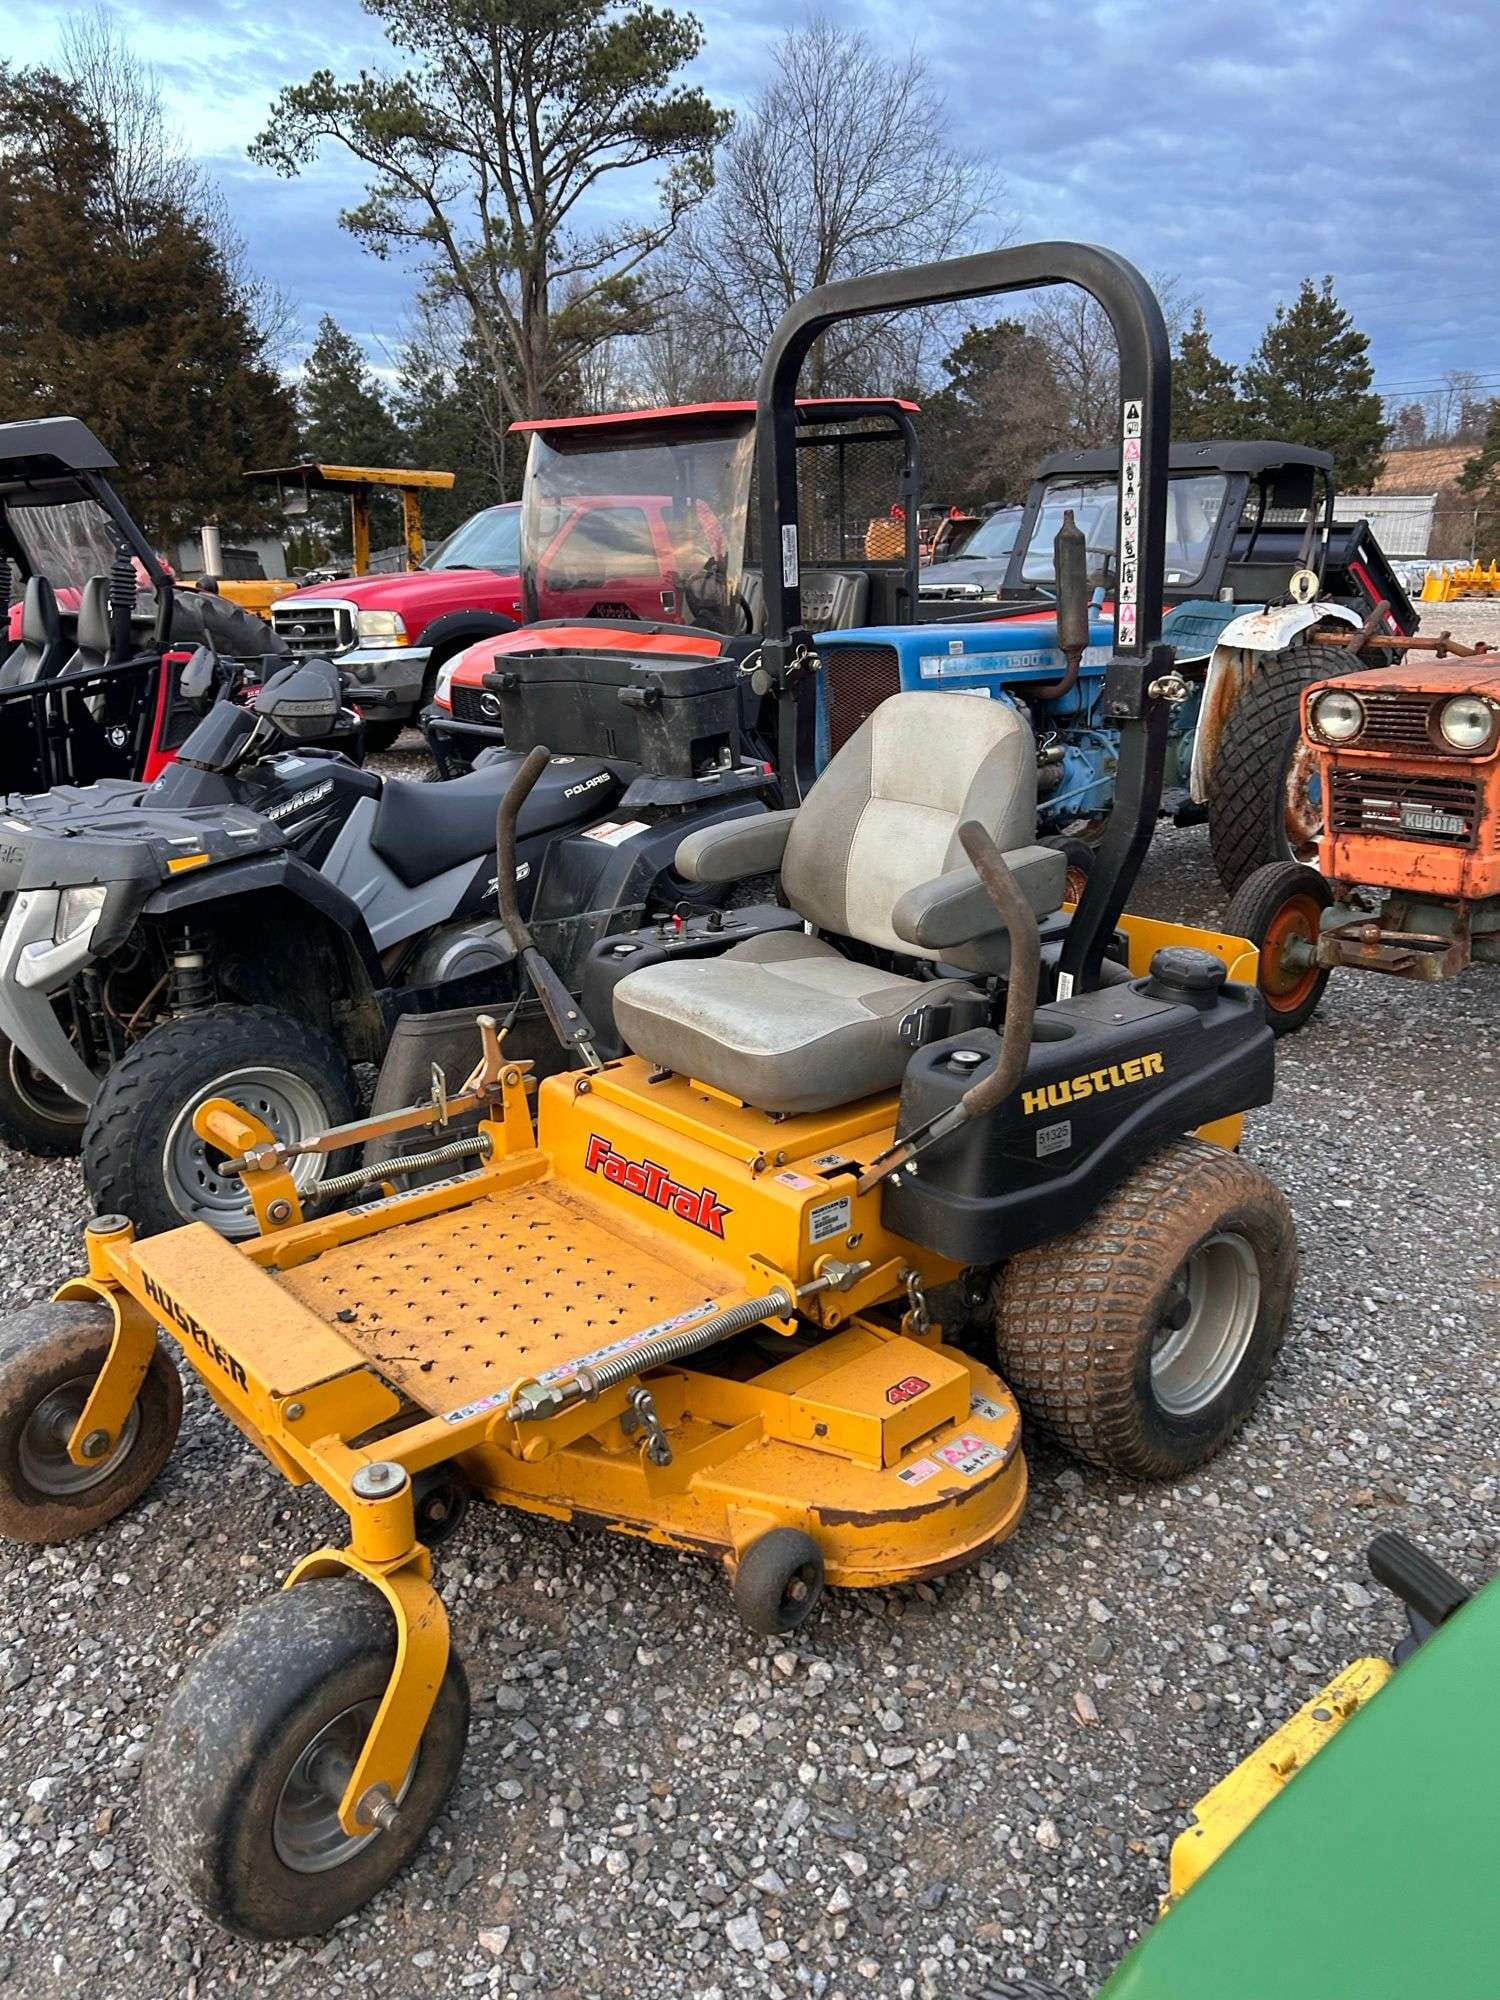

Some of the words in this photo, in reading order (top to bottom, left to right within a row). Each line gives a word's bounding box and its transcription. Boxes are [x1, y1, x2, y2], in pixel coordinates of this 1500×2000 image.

[563, 772, 611, 798] POLARIS
[1405, 812, 1460, 832] KUBOTA
[1021, 1051, 1165, 1115] HUSTLER
[1039, 1125, 1069, 1145] 51325
[584, 1132, 734, 1240] FasTrak
